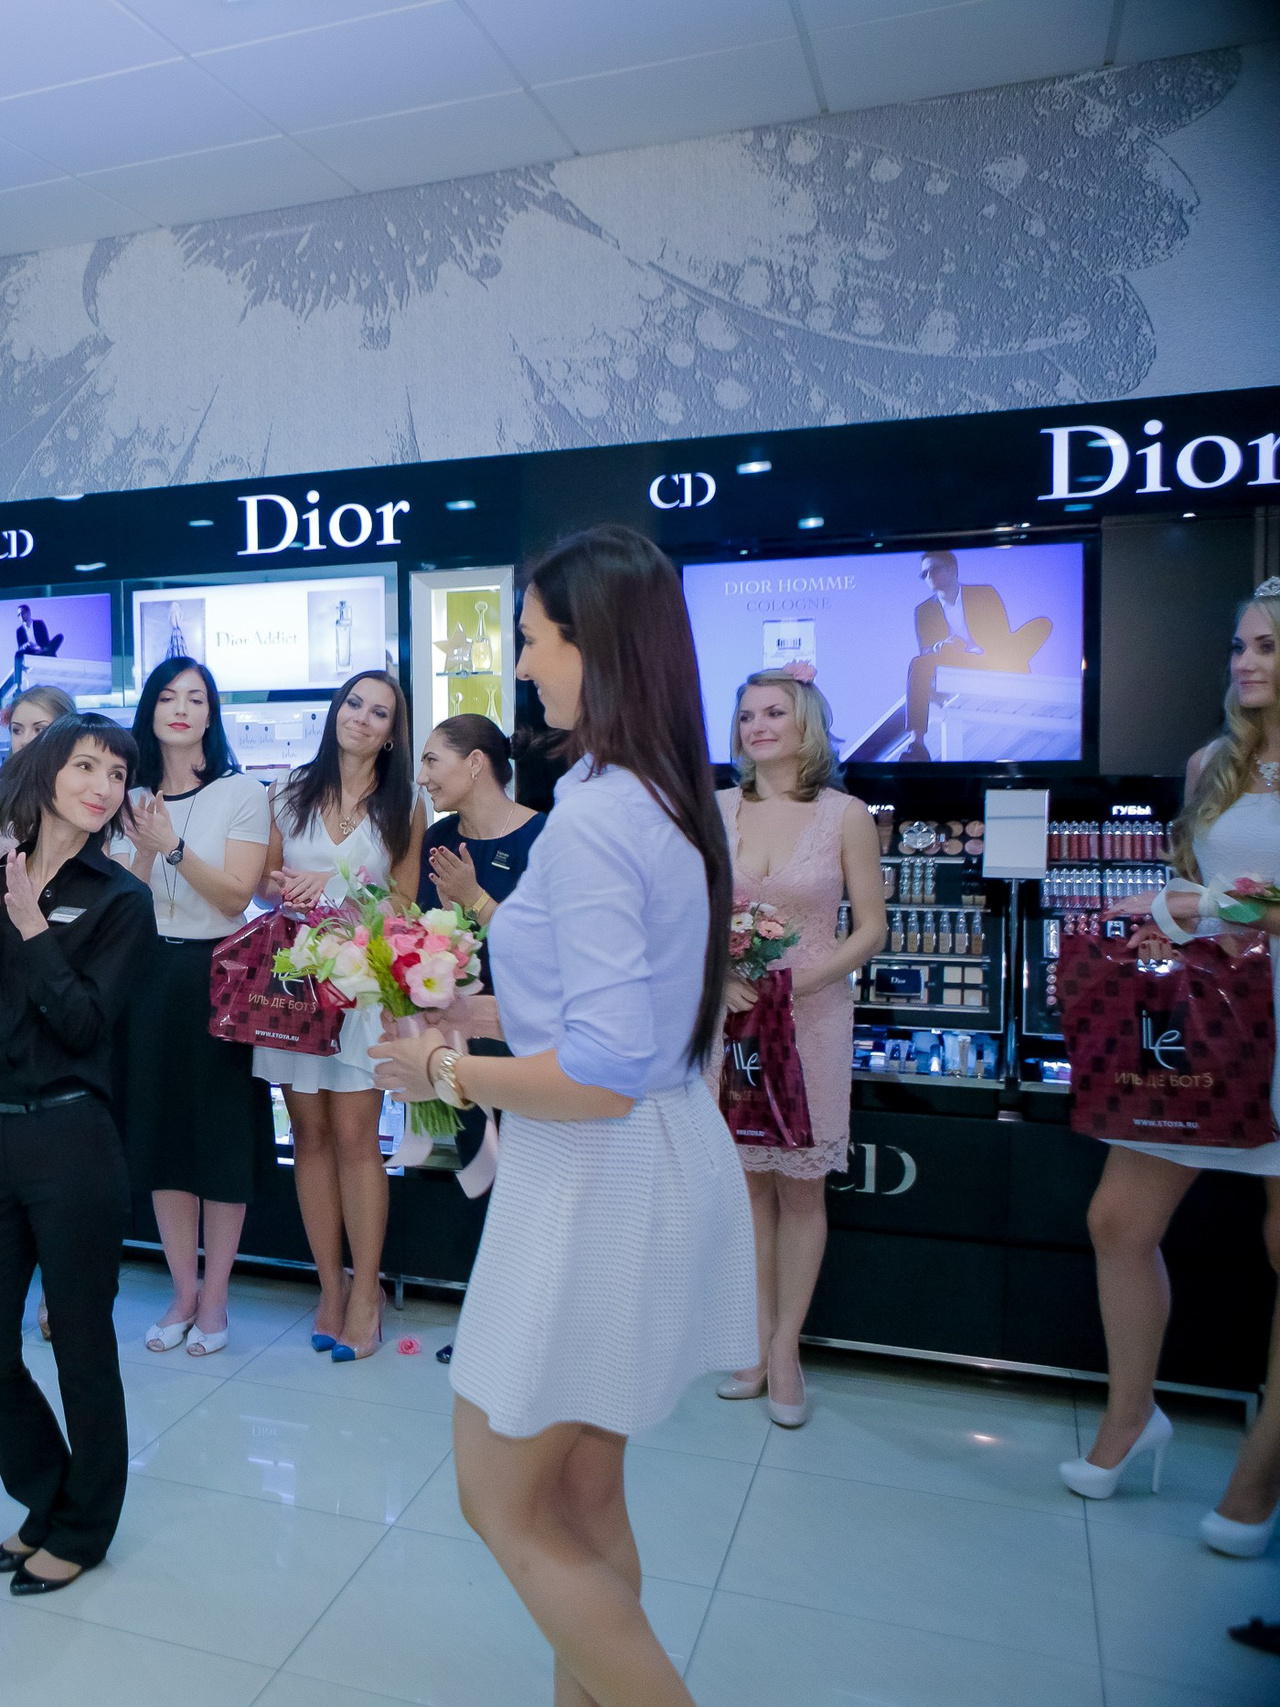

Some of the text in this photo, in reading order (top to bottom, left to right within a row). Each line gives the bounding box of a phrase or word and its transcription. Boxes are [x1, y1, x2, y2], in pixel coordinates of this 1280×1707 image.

[1037, 419, 1280, 500] Dior
[236, 489, 411, 556] Dior
[725, 574, 857, 596] DIOR HOMME
[746, 597, 832, 613] COLOGNE
[216, 630, 297, 647] Dior Addict
[1112, 805, 1152, 816] ГУБЫ
[248, 993, 269, 1006] ИЛЬ
[271, 998, 286, 1010] ДЕ
[1114, 1071, 1143, 1086] ИЛЬ
[1147, 1074, 1166, 1088] ДЕ
